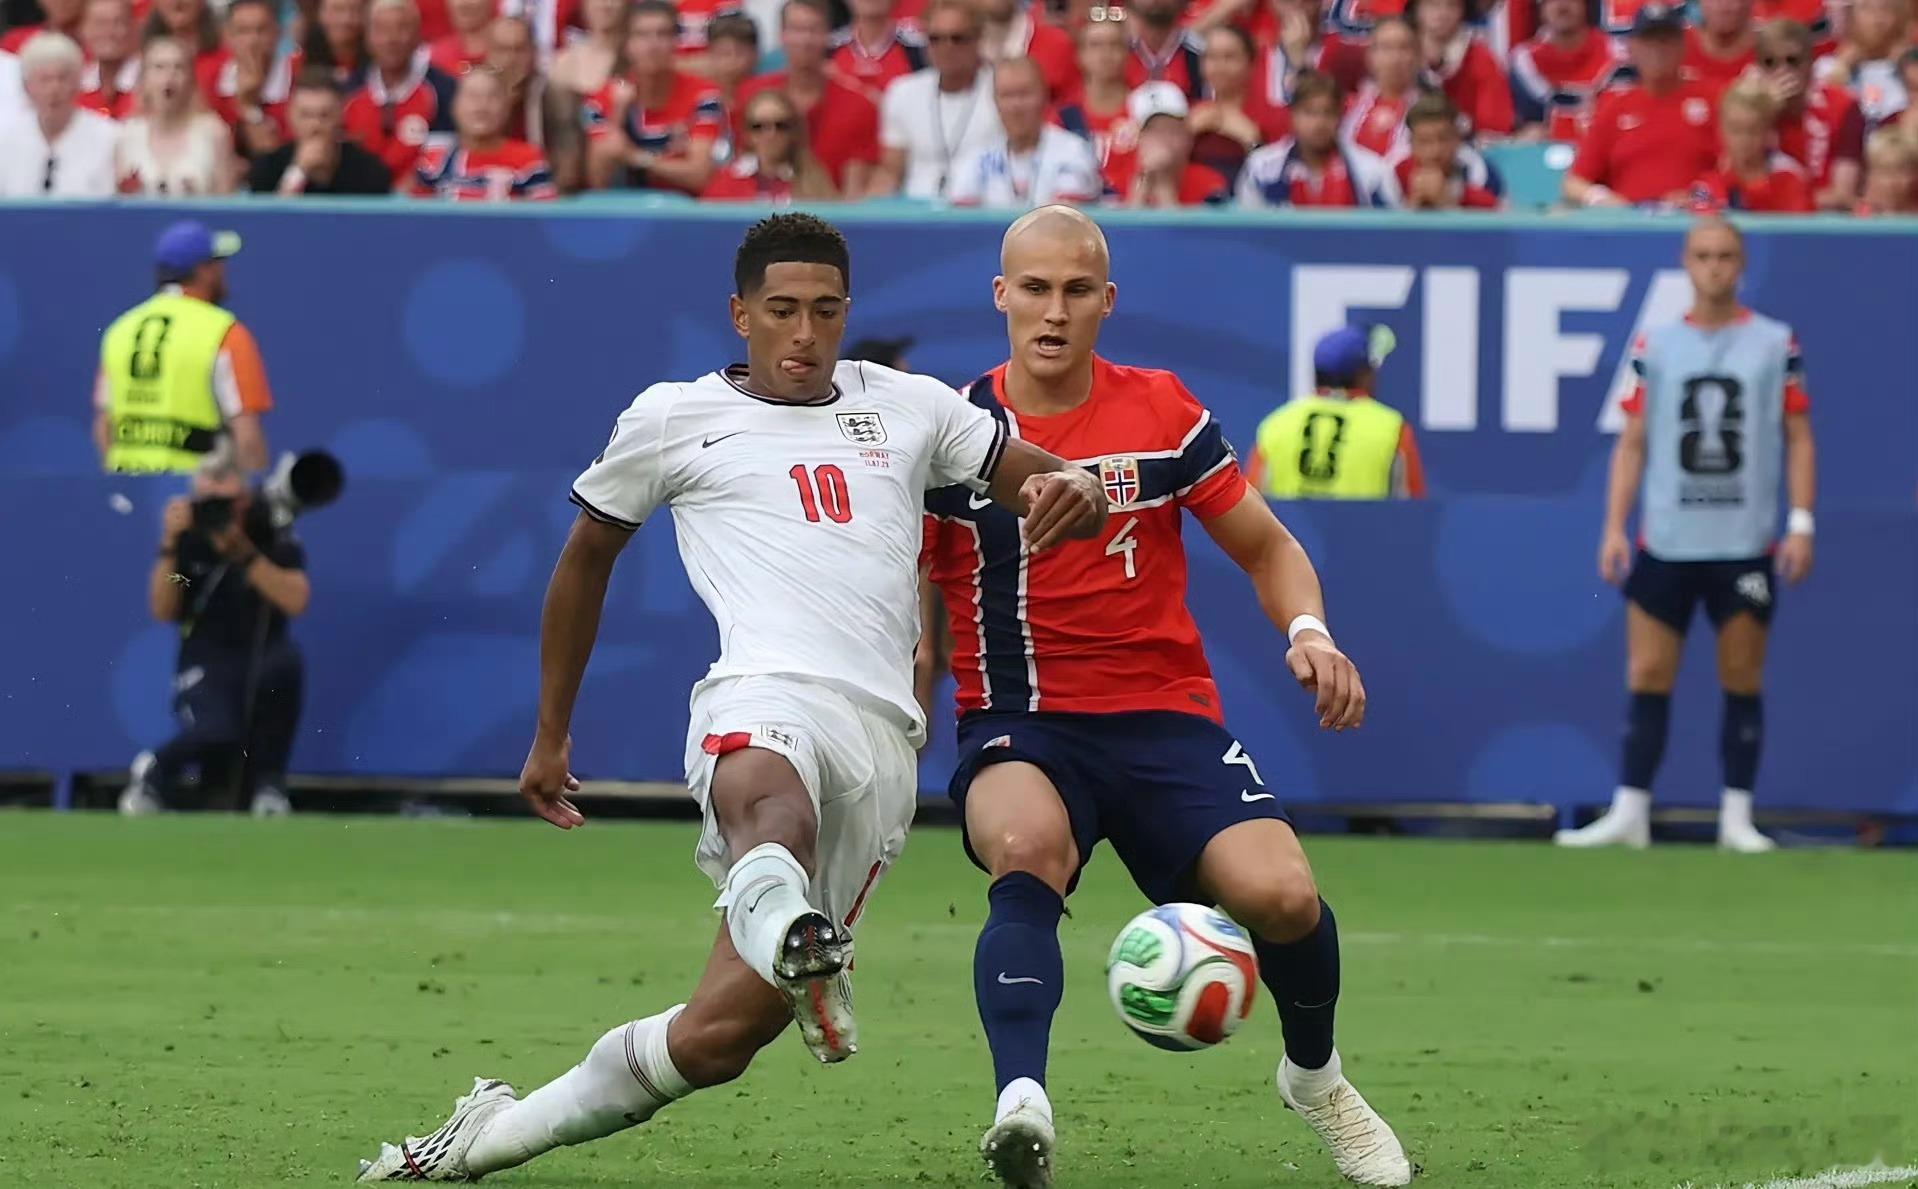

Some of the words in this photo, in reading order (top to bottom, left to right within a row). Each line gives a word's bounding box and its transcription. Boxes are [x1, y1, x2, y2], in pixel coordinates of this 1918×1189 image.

[789, 464, 853, 523] 10
[1105, 516, 1139, 578] 4
[1222, 740, 1265, 786] 4
